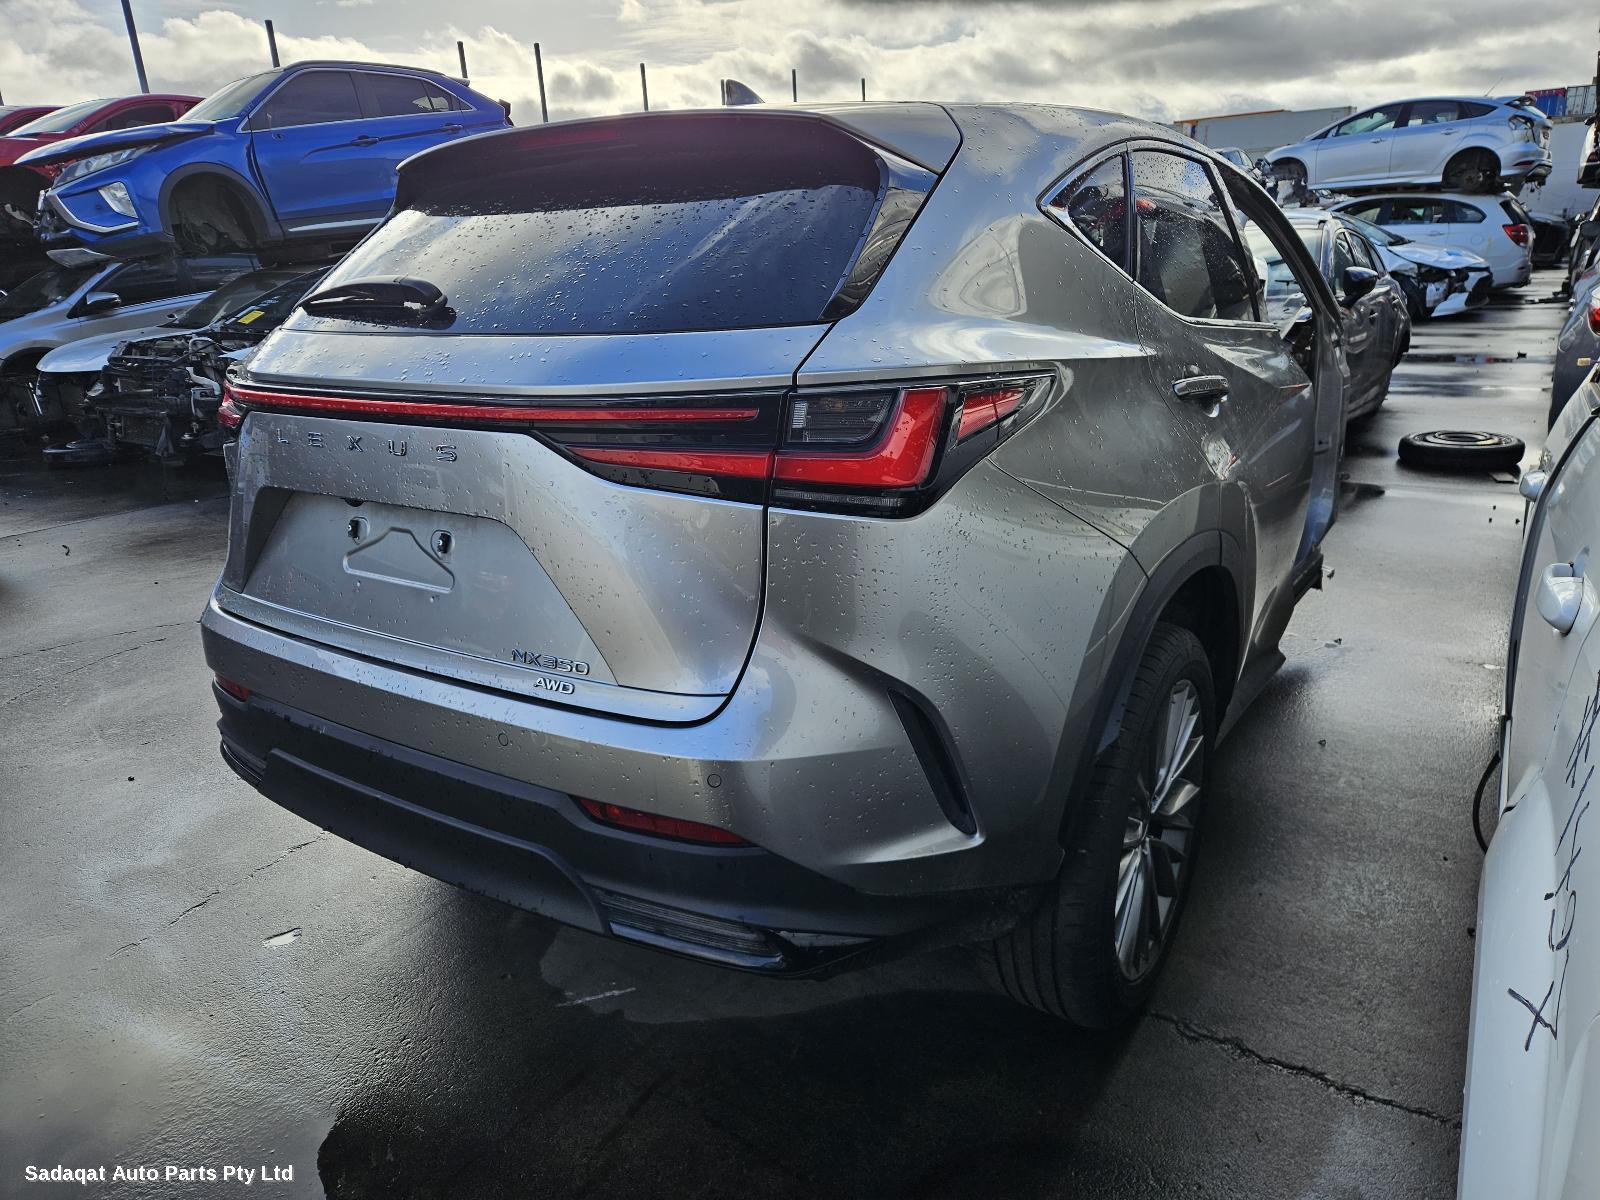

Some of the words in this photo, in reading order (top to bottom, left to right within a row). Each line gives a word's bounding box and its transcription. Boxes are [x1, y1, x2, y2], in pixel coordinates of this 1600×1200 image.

[276, 428, 458, 462] LEXUS
[511, 648, 590, 676] NX350
[534, 677, 576, 695] AWD
